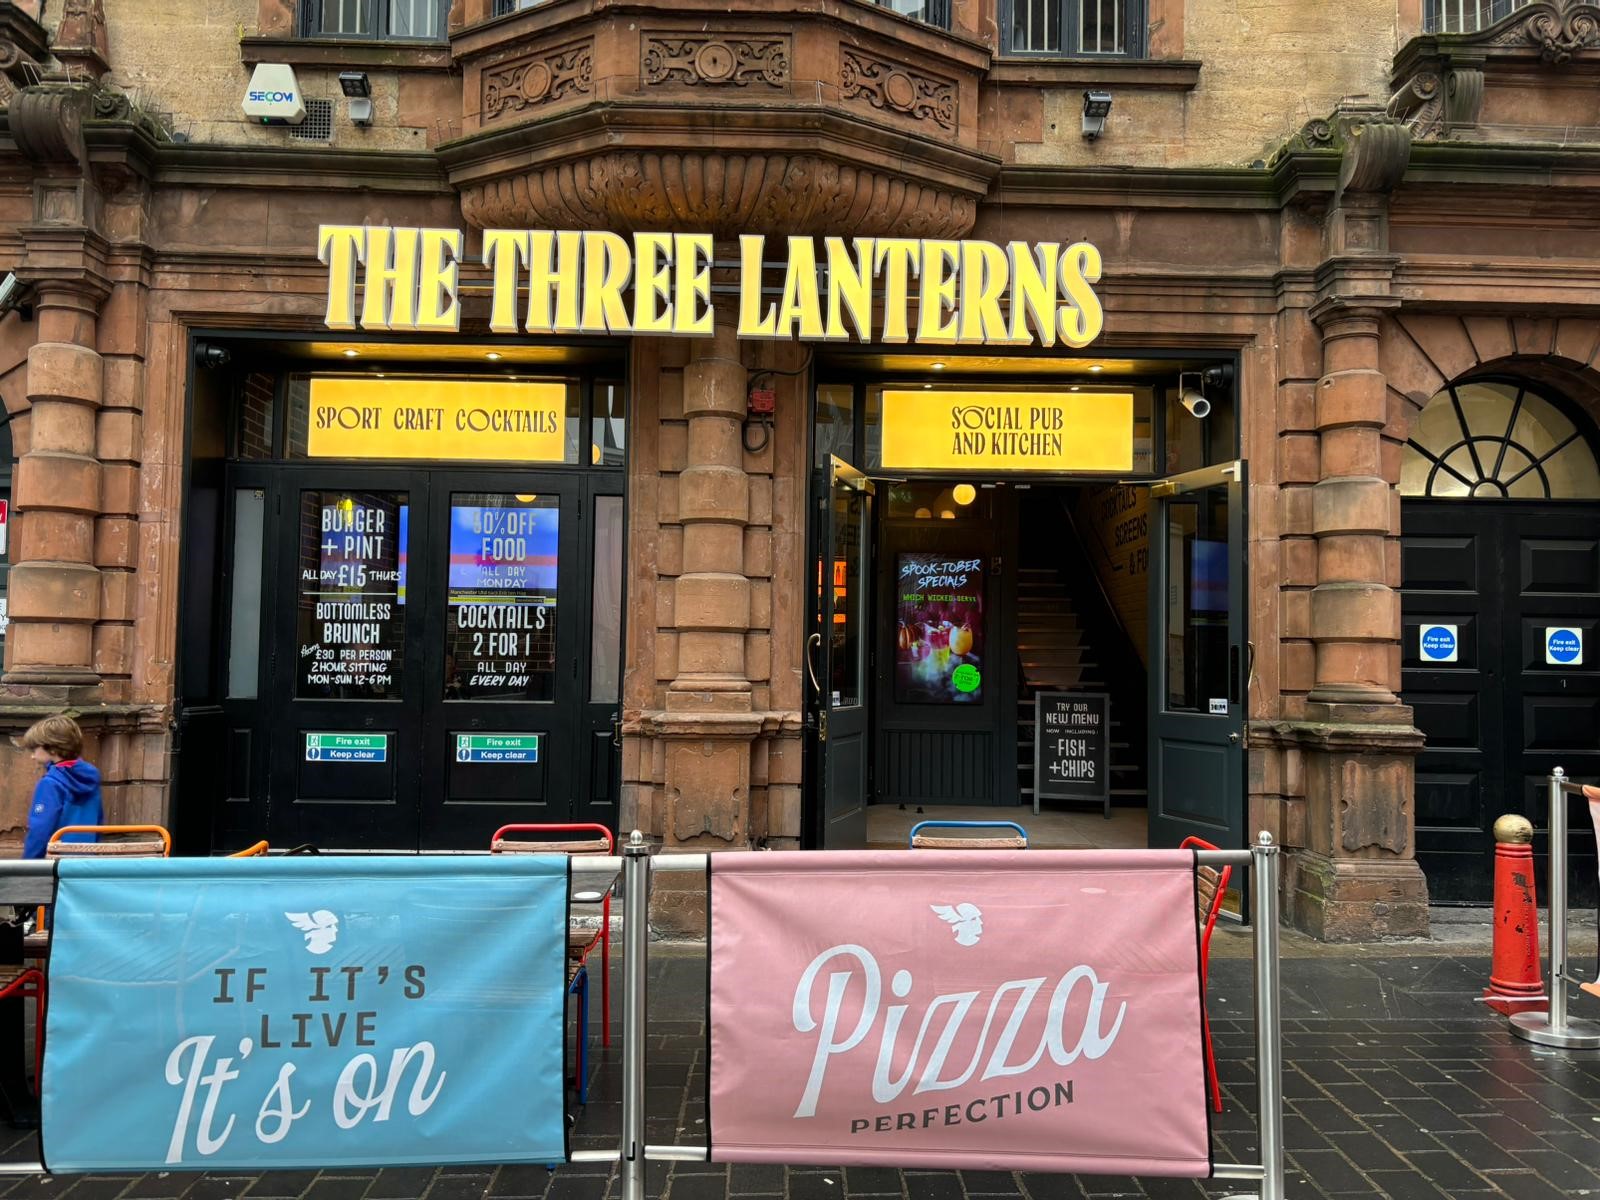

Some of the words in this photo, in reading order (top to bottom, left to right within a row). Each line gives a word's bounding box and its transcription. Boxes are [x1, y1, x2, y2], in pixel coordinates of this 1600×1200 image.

[249, 91, 294, 103] SECOM
[318, 225, 464, 333] THE
[482, 229, 714, 337] THREE
[737, 234, 1104, 348] LANTERNS
[316, 406, 382, 430] SPORT
[393, 407, 445, 431] CRAFT
[455, 408, 558, 434] COCKTAILS
[951, 405, 1023, 430] SOCIAL
[1029, 407, 1064, 431] PUB
[951, 432, 986, 456] AND
[991, 432, 1062, 456] KITCHEN
[344, 535, 385, 560] PINT
[481, 537, 526, 561] FOOD
[302, 569, 319, 581] ALL
[320, 570, 338, 581] DAY
[338, 564, 368, 588] £15
[369, 570, 403, 582] THURS
[481, 566, 501, 577] ALL
[507, 566, 527, 577] DAY
[901, 559, 981, 579] SPOOK-TOBER
[477, 578, 528, 589] MONDAY
[917, 575, 968, 590] SPECIALS
[316, 602, 392, 620] BOTTOMLESS
[457, 605, 547, 630] COCKTAILS
[323, 622, 381, 644] BRUNCH
[473, 632, 484, 656] 2
[488, 632, 518, 656] FOR
[340, 650, 356, 661] PER
[312, 662, 319, 673] 2
[320, 662, 347, 672] HOUR
[348, 662, 388, 673] SITTING
[477, 661, 497, 673] ALL
[505, 662, 527, 673] DAY
[469, 675, 506, 686] EVERY
[508, 675, 530, 687] DAY
[1056, 702, 1070, 711] TRY
[1073, 703, 1088, 712] OUR
[1046, 712, 1068, 724] NEW
[1071, 713, 1099, 725] MENU
[335, 737, 352, 745] Fire
[354, 738, 370, 746] exit
[486, 738, 503, 746] Fire
[505, 738, 521, 746] exit
[330, 750, 352, 759] Keep
[354, 750, 375, 759] clear
[480, 751, 503, 760] Keep
[504, 751, 526, 760] clear
[213, 967, 267, 1003] IF
[309, 964, 426, 1001] IT'S
[261, 1011, 377, 1048] LIVE
[792, 944, 1127, 1118] Pizza
[164, 1035, 311, 1164] It's
[333, 1041, 447, 1129] on
[851, 1080, 1075, 1134] PERFECTION
